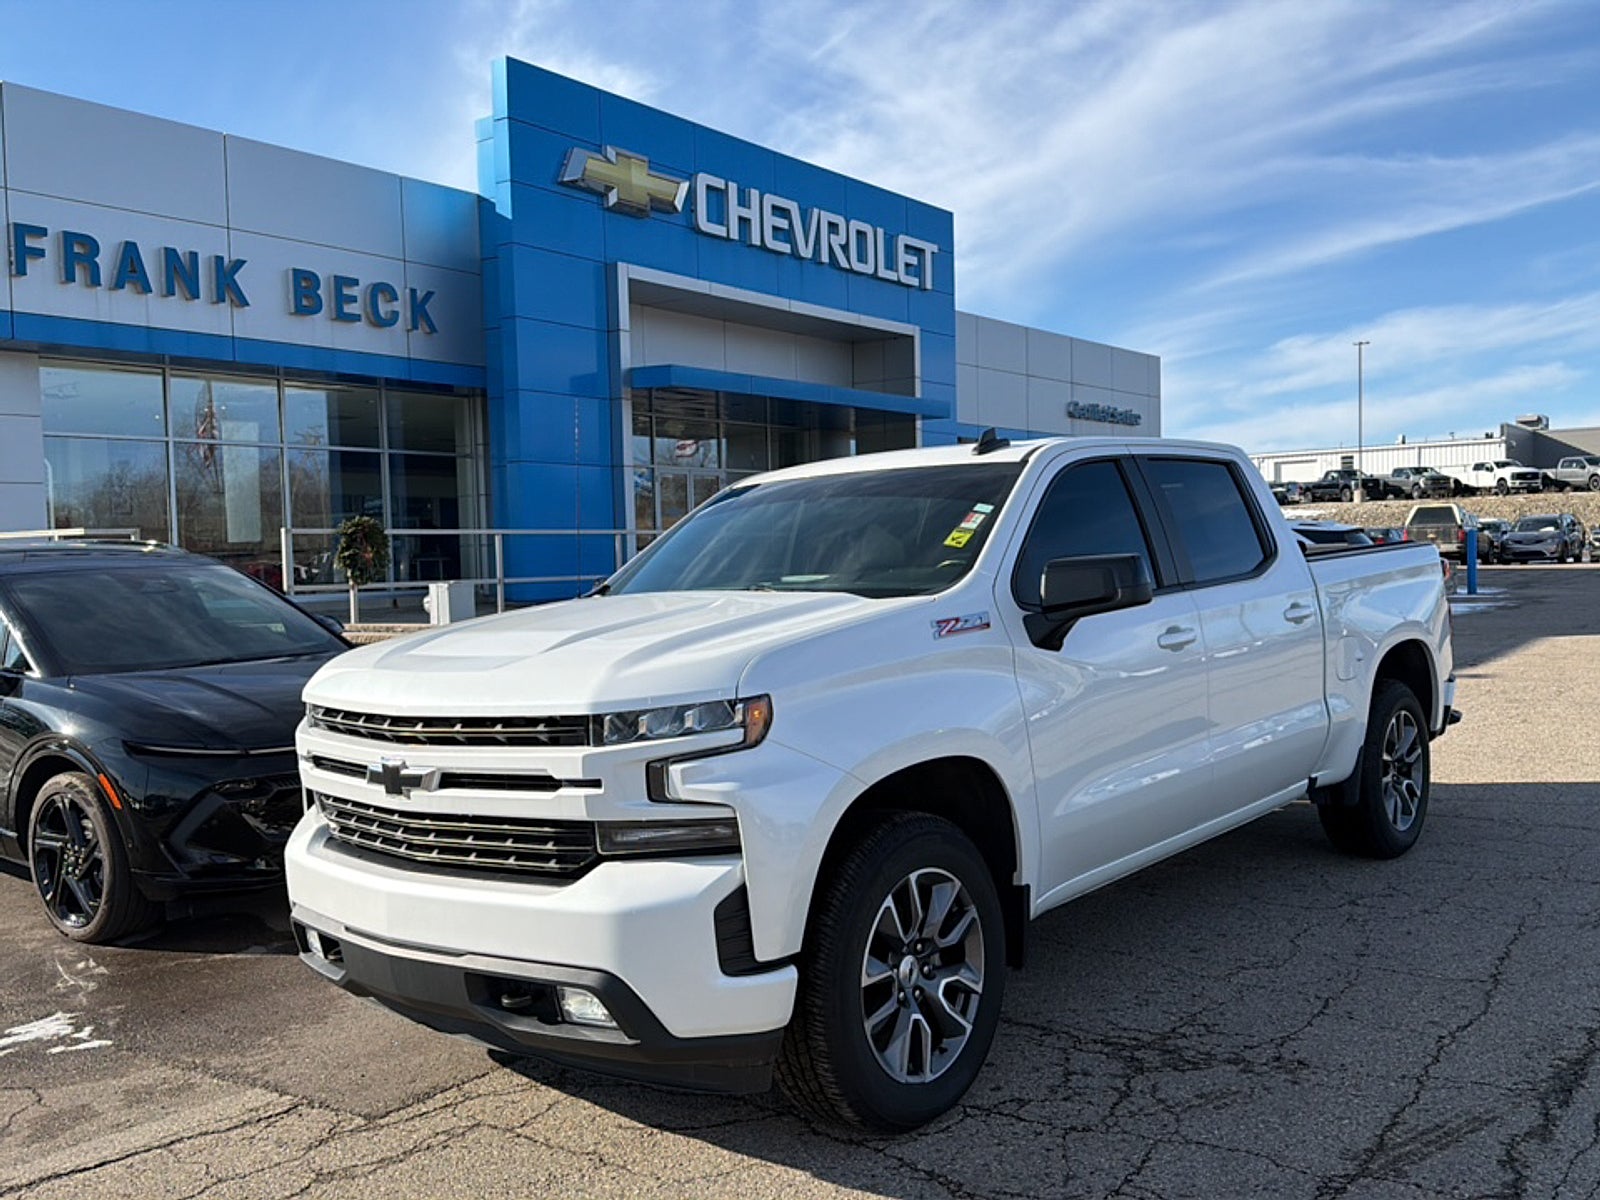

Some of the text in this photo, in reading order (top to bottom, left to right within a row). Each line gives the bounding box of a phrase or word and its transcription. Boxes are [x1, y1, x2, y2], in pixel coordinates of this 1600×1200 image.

[11, 222, 438, 334] FRANK BECK
[694, 172, 939, 291] CHEVROLET
